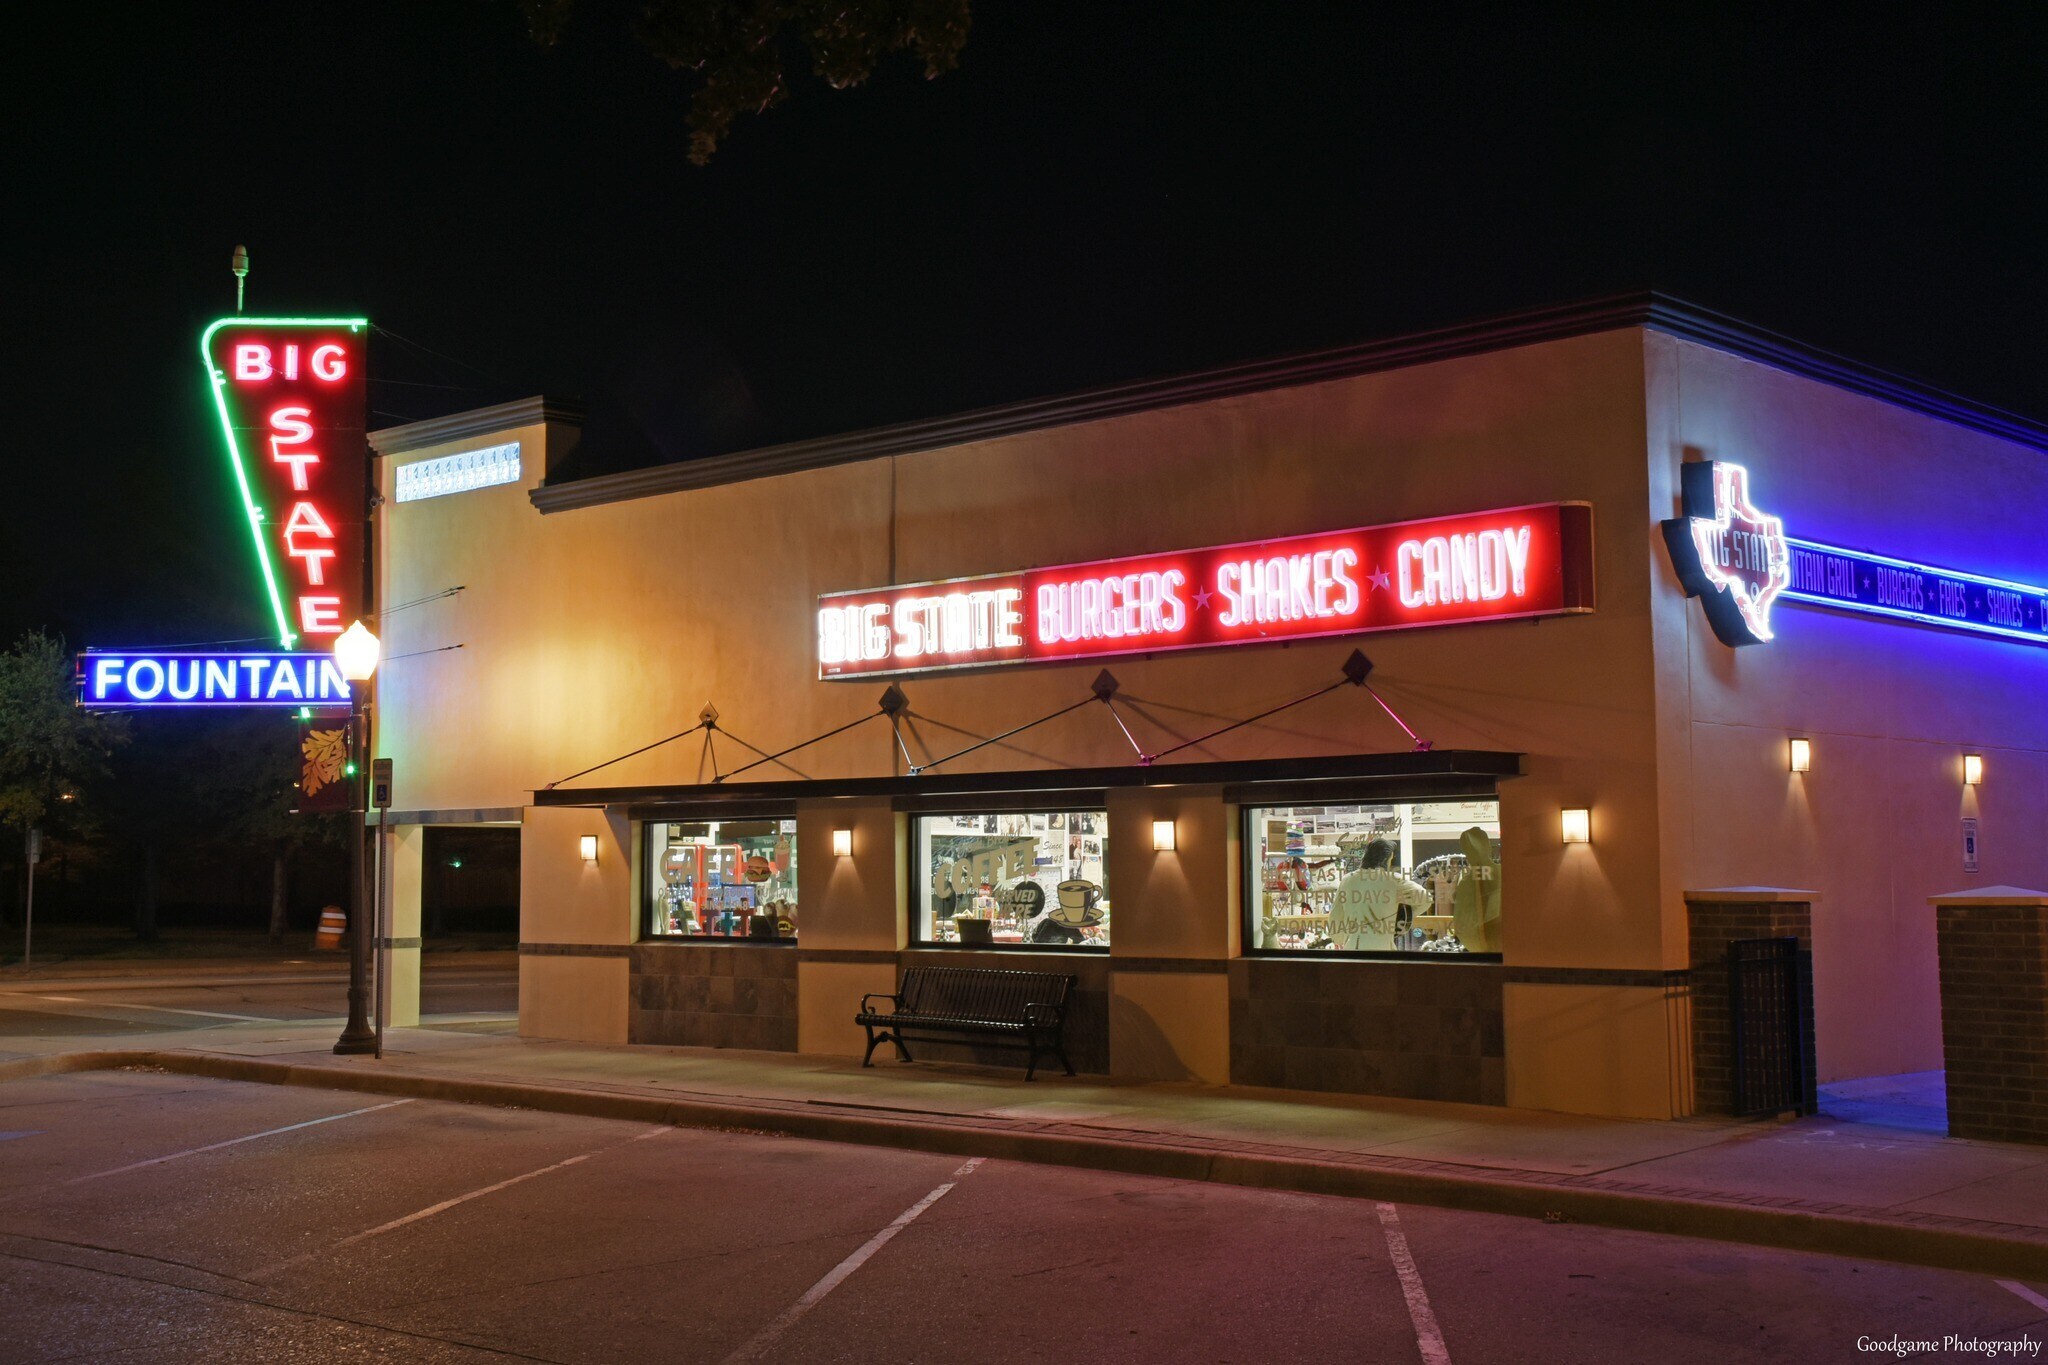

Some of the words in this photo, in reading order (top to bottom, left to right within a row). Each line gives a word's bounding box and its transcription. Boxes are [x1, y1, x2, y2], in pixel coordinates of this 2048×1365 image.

[233, 343, 349, 383] BIG
[268, 406, 345, 635] STATE
[1705, 525, 1730, 568] IG
[818, 602, 891, 664] BIG
[894, 588, 1022, 658] STATE
[1037, 568, 1187, 645] BURGERS
[1217, 547, 1359, 628] SHAKES
[1396, 525, 1532, 610] CANDY
[1787, 548, 1825, 594] NTAIN
[1826, 556, 1858, 599] GRILL
[1876, 566, 1924, 611] BURGERS
[1938, 578, 1967, 618] FRIES
[1986, 588, 2023, 628] SHAKES
[95, 658, 351, 701] FOUNTAIN
[934, 838, 1041, 899] COFFEE
[1261, 867, 1345, 882] BREAKFAST
[1360, 867, 1413, 882] LUNCH
[1428, 865, 1492, 881] SUPPER
[994, 889, 1037, 903] SERVED
[1290, 890, 1336, 906] OPEN
[1351, 889, 1391, 904] DAYS
[1279, 920, 1368, 936] HOMEMADE
